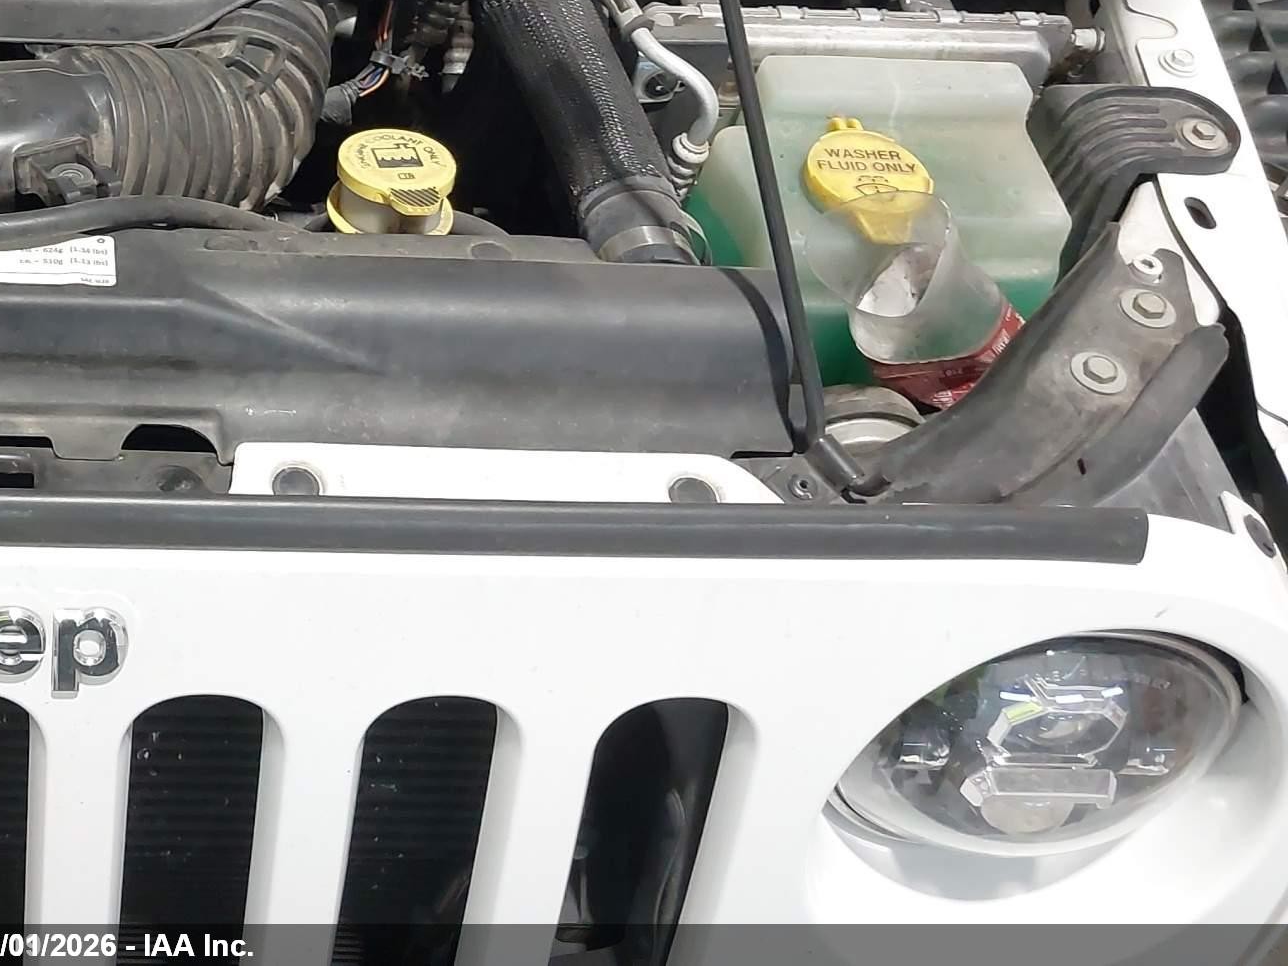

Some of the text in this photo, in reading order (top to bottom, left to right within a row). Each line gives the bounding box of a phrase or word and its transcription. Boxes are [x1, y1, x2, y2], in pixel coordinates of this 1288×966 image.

[365, 133, 424, 146] COOLANT
[423, 146, 447, 168] ONLY
[823, 147, 902, 161] WASHER
[816, 159, 917, 174] FLUID ONLY
